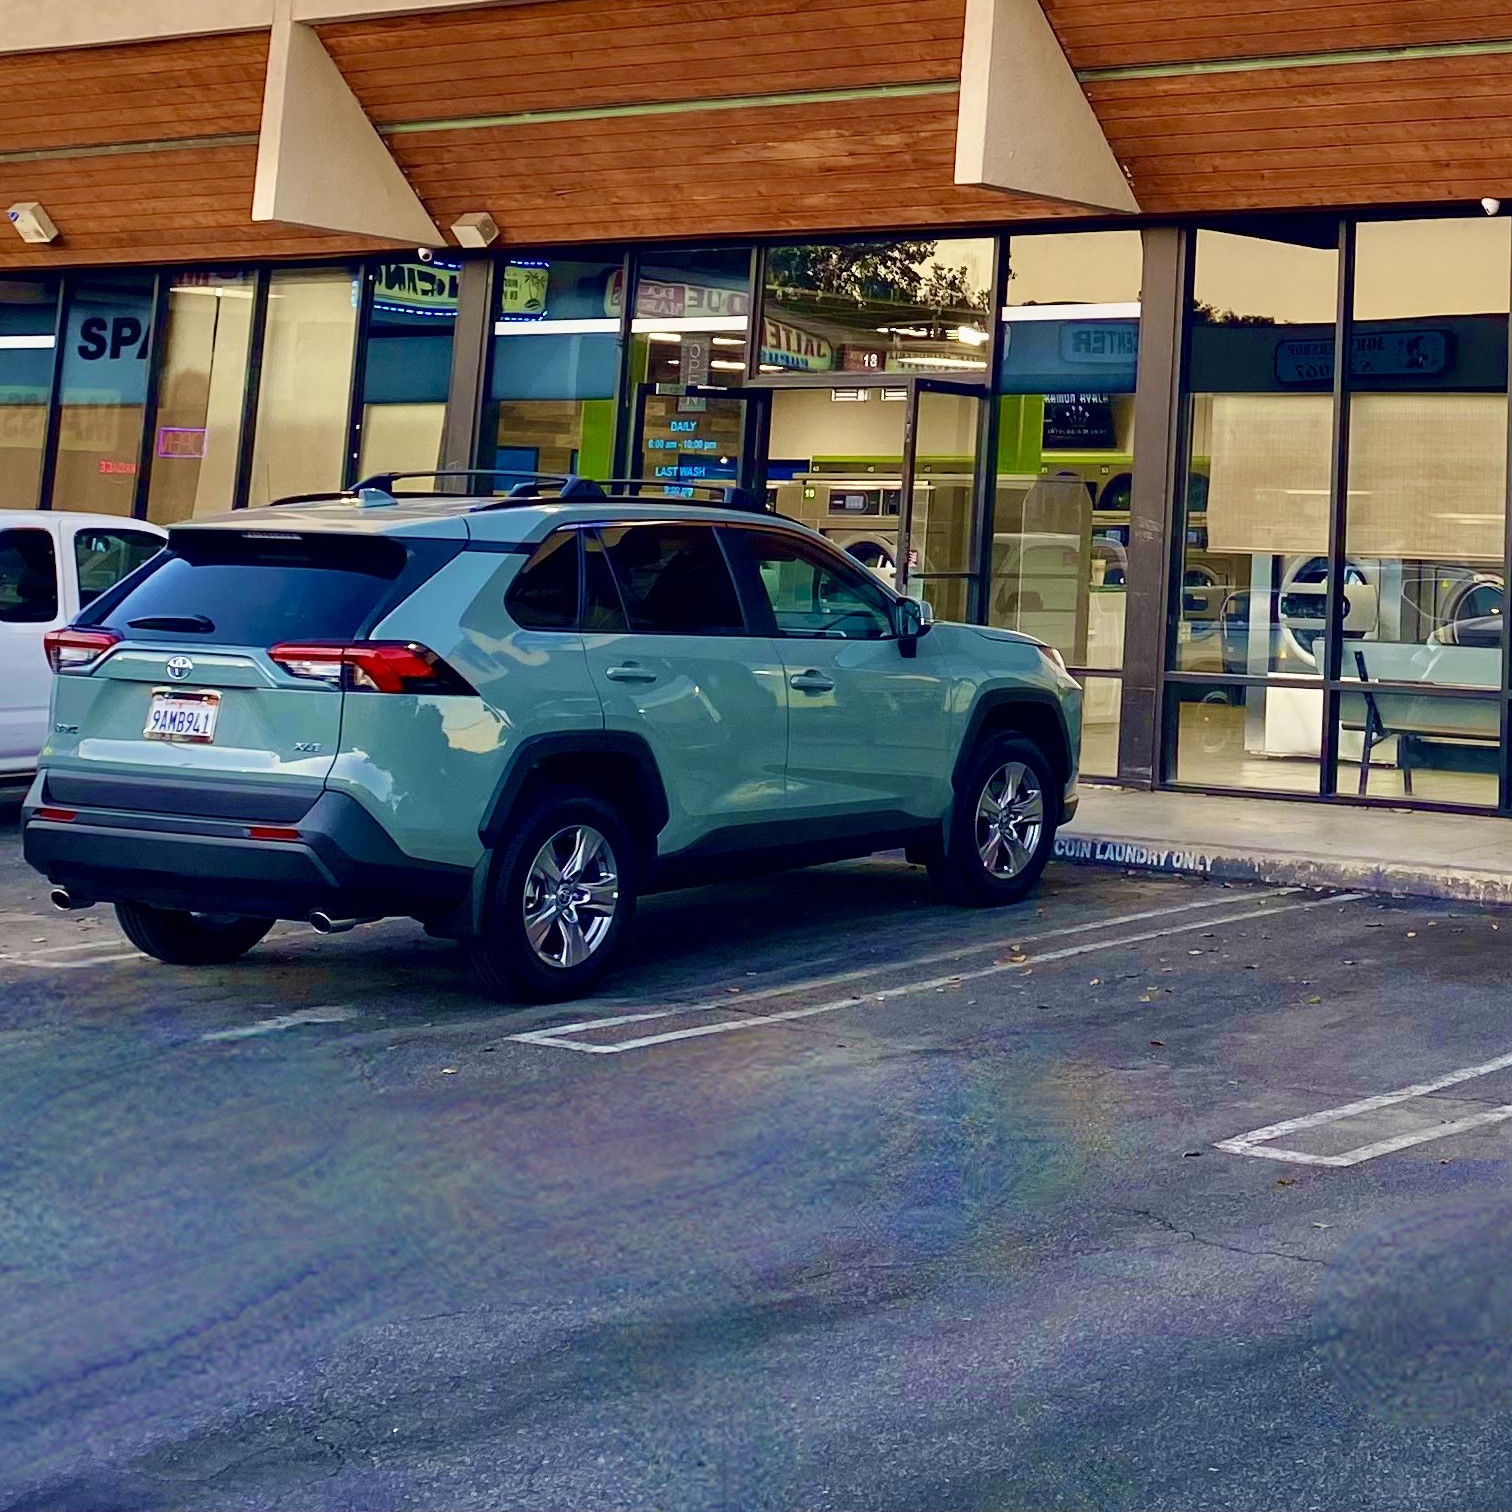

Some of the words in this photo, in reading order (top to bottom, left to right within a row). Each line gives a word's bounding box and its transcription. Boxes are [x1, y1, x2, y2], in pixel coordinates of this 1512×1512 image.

[78, 317, 149, 361] SP
[863, 354, 878, 368] 18
[671, 421, 697, 432] DAILY
[704, 442, 717, 452] pm
[655, 467, 678, 477] LAST
[679, 467, 706, 477] WASH
[151, 710, 209, 734] 9AMB941
[1054, 839, 1093, 858] COIN
[1094, 842, 1171, 867] LAUNDRY
[1172, 850, 1215, 872] ONLY
